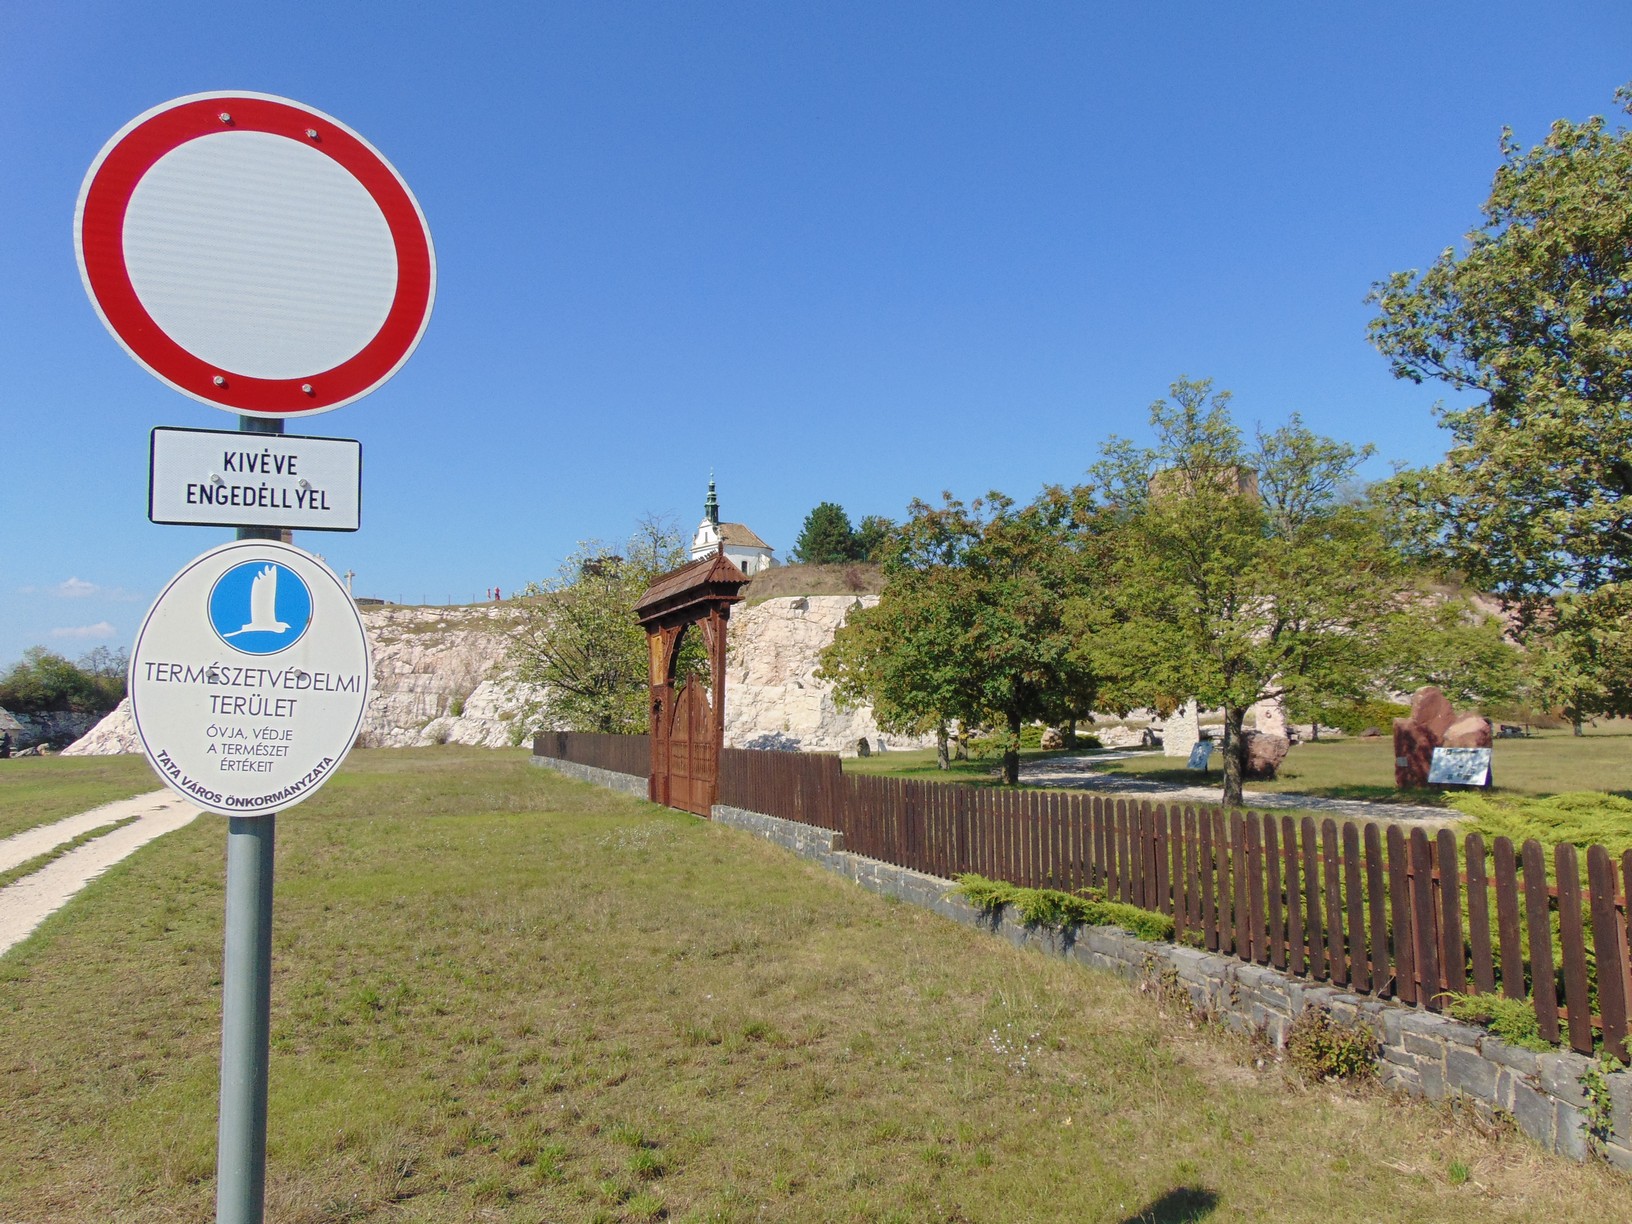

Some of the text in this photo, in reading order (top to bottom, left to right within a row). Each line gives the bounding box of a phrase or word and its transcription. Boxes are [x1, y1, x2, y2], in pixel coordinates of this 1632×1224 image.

[224, 448, 298, 475] KIVÉVE
[187, 482, 331, 510] ENGEDÉLLYEL
[145, 661, 361, 693] TERMÉSZETVÉDELMI
[210, 694, 297, 717] TERÜLET
[206, 724, 293, 741] ÓVJA, VÉDJE
[206, 742, 289, 757] A TERMÉSZET
[220, 758, 274, 772] ÉRTÉKEIT
[156, 749, 334, 807] TATA VÁROS ÖNKORMÁNYZATA
